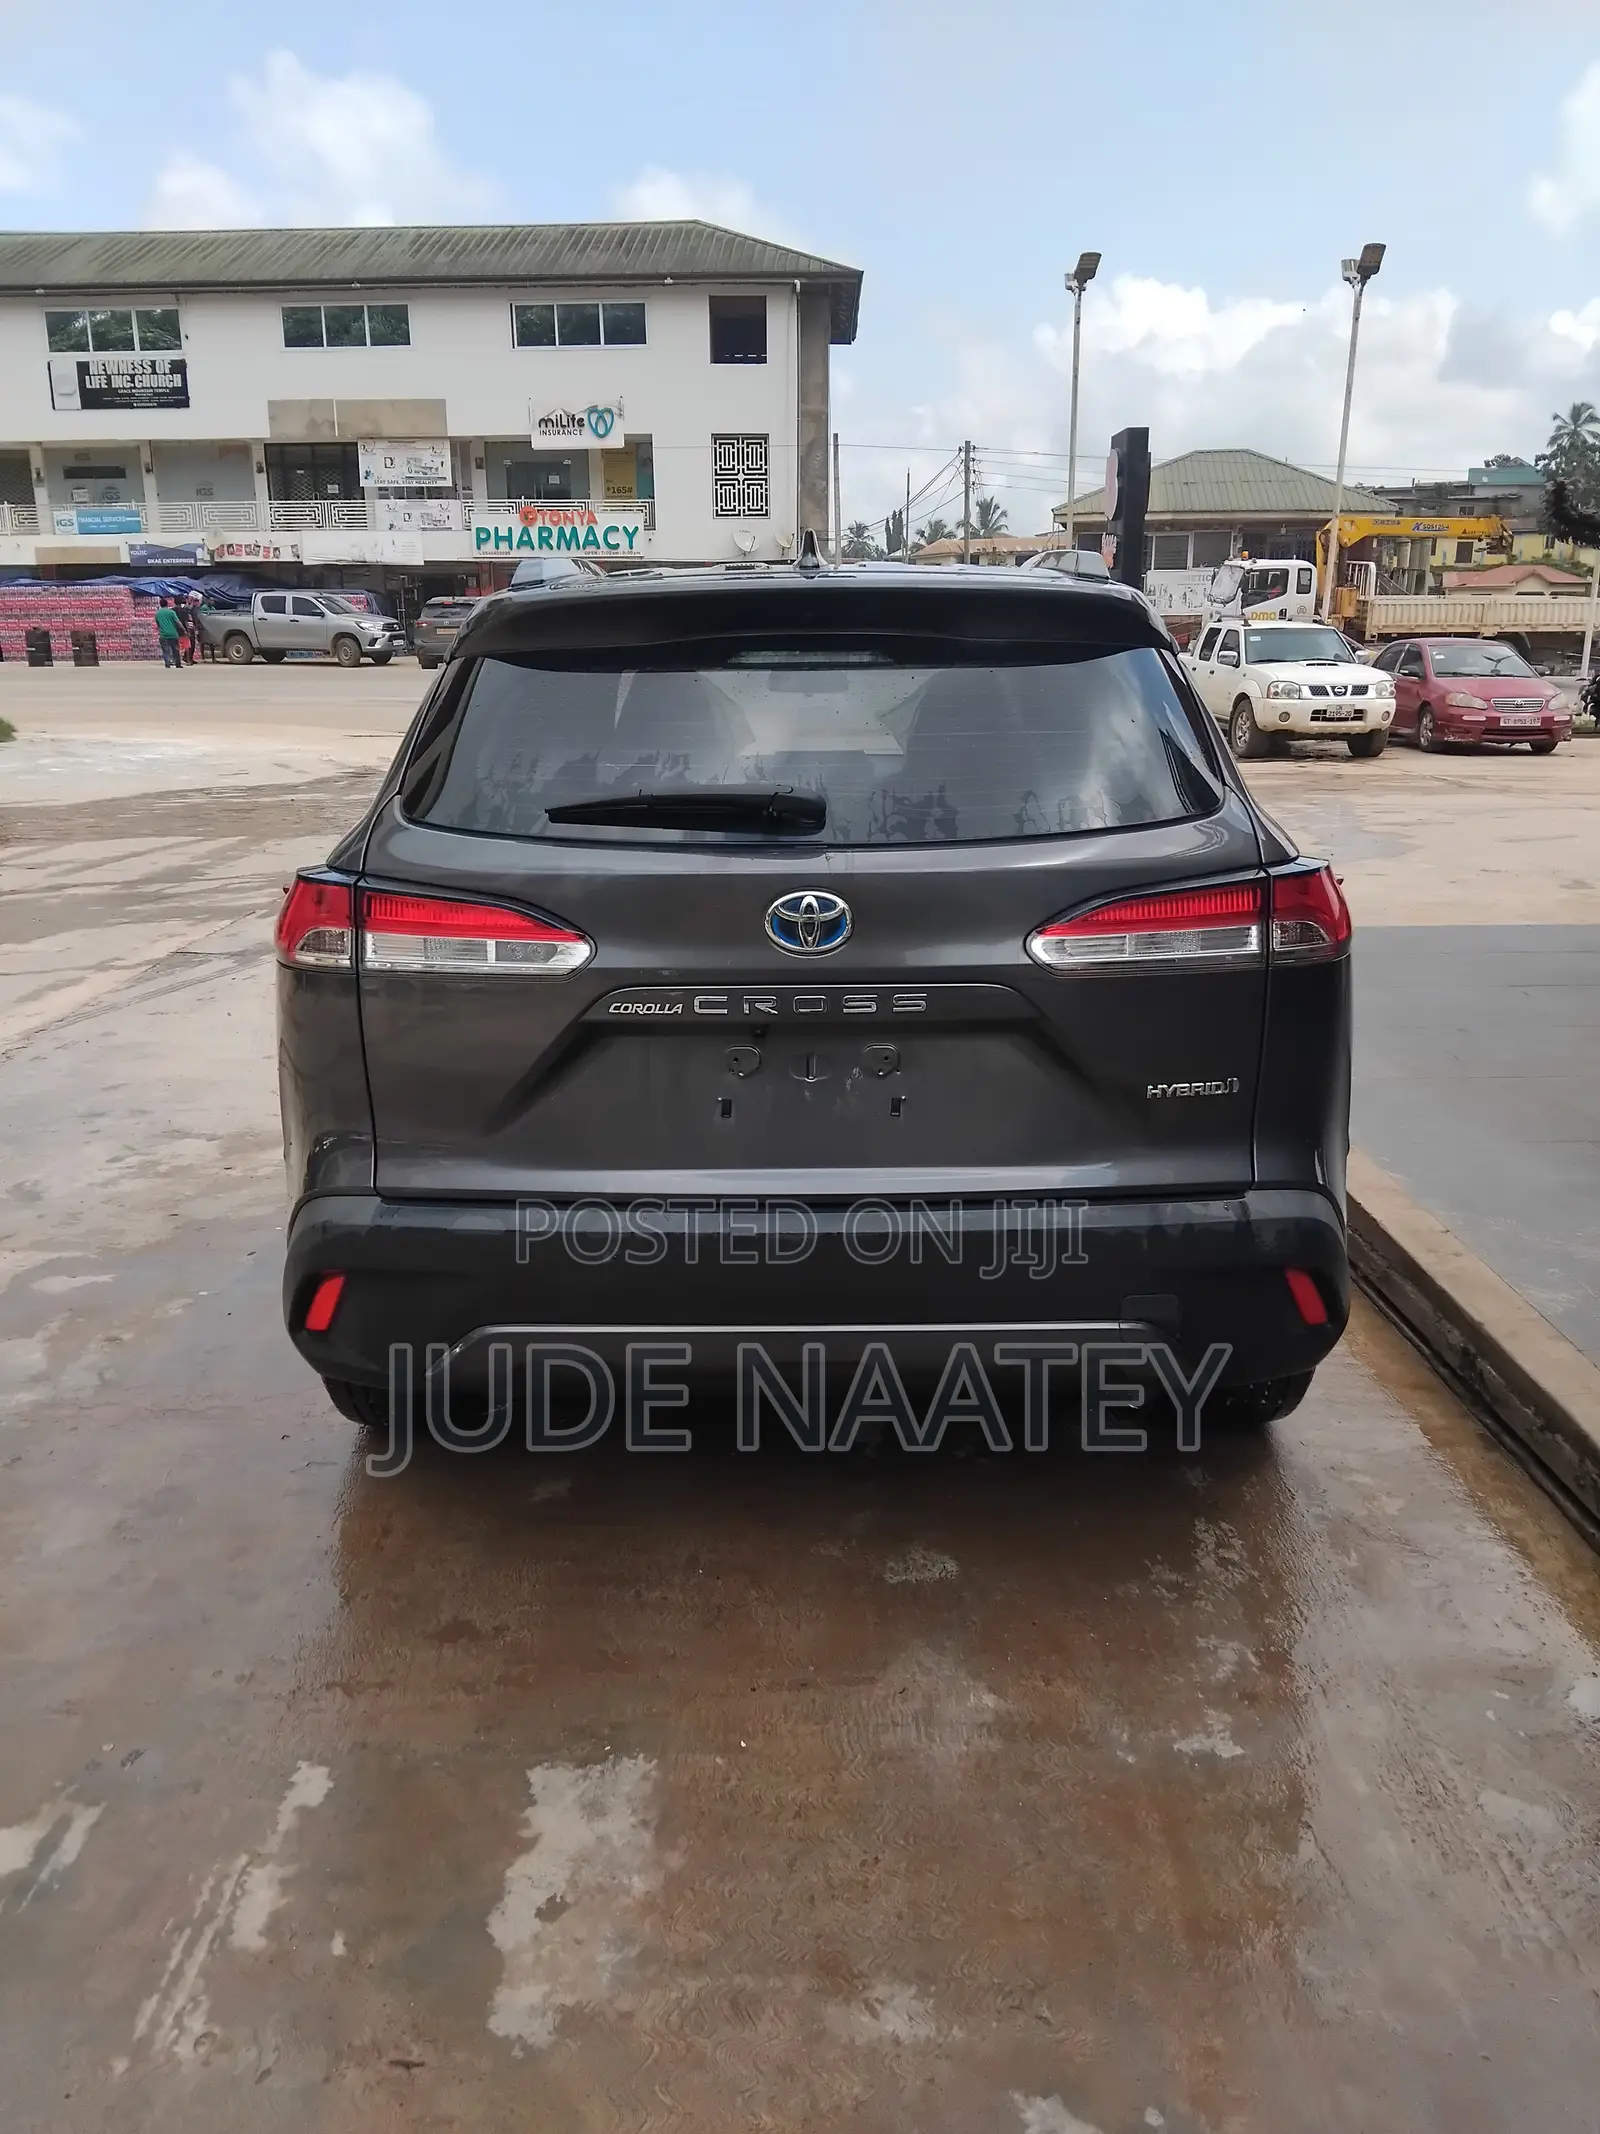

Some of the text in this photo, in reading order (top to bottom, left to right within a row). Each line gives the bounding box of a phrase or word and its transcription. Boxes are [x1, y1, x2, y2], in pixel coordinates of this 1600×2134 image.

[89, 359, 171, 374] NEWNESS OF
[85, 375, 108, 388] LIFE
[134, 373, 182, 388] CHURCH
[538, 414, 585, 428] miLife
[56, 519, 75, 528] IGS
[77, 515, 127, 524] FINANCIAL SERVICES
[475, 525, 639, 550] PHARMACY
[163, 557, 196, 565] ENTERPRISE
[608, 994, 928, 1015] COROLLA CROSS
[1146, 1081, 1226, 1099] HYBRID
